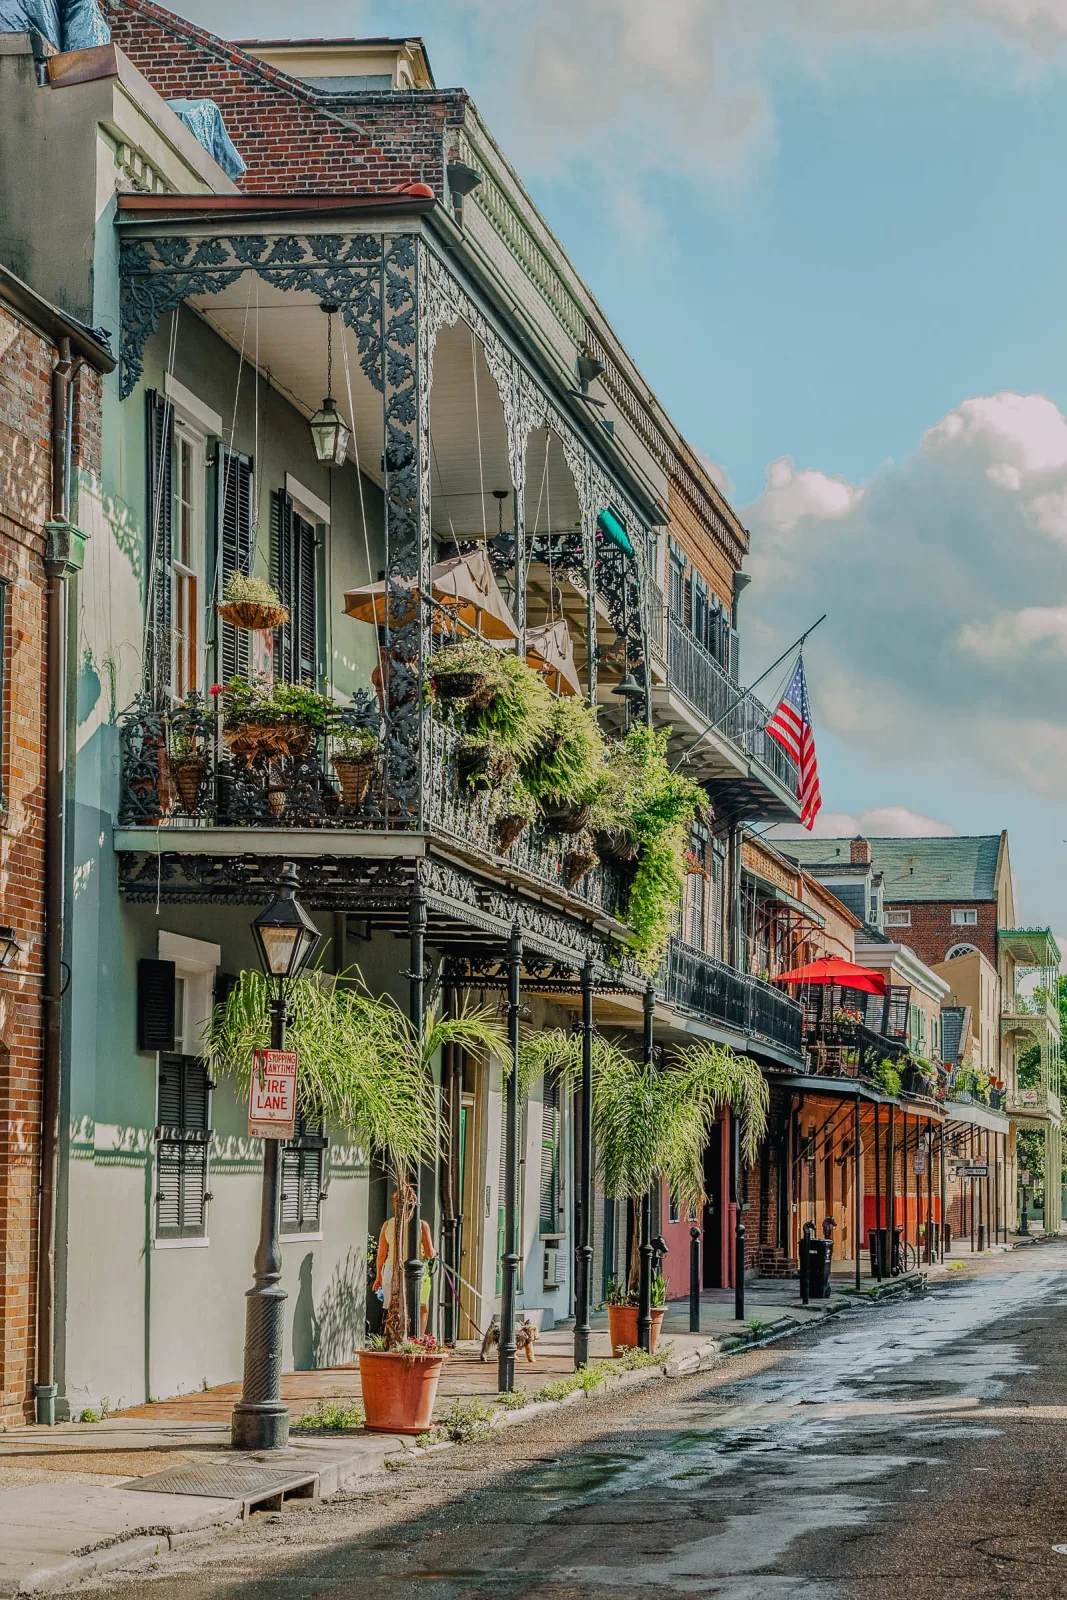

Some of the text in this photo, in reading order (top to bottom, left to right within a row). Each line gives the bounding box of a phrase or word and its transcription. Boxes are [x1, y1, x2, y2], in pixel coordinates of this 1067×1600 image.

[268, 1054, 296, 1064] STOPPING
[268, 1064, 295, 1074] ANYTIME
[260, 1079, 287, 1094] FIRE
[257, 1096, 288, 1110] LANE
